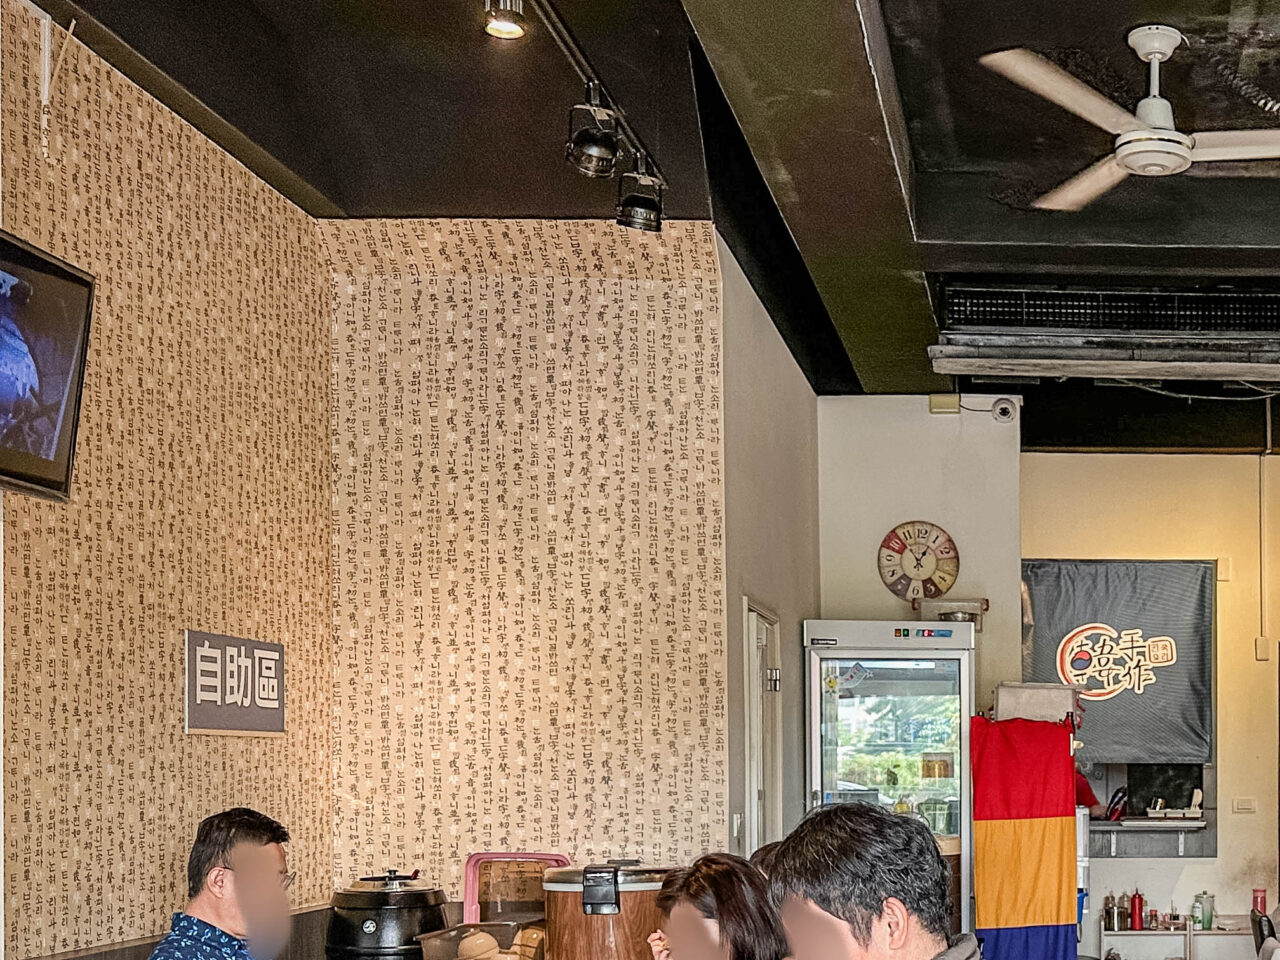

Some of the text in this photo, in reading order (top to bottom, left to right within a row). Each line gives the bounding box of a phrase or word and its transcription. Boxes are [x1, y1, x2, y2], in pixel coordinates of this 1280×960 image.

[902, 530, 912, 540] 11
[916, 528, 928, 539] 12
[932, 535, 940, 544] 1
[939, 547, 951, 555] 2
[886, 554, 895, 562] 9
[912, 586, 920, 596] 6
[196, 640, 280, 708] 自助區
